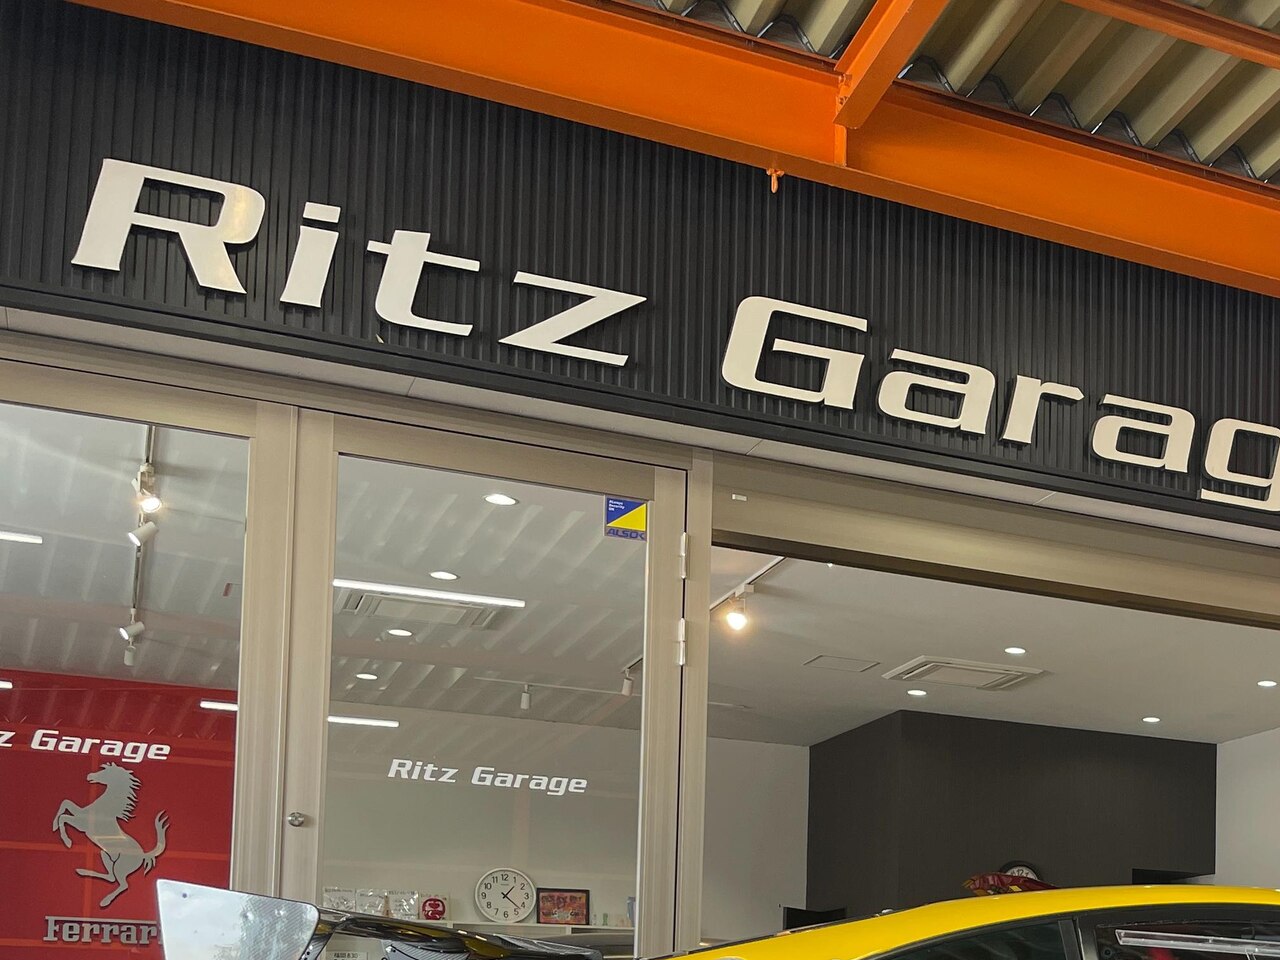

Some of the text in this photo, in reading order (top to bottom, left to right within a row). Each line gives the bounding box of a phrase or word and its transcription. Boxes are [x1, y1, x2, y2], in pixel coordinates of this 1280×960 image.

[71, 157, 647, 367] Ritz
[608, 528, 646, 540] ALSOK
[30, 729, 171, 763] Garage
[387, 758, 588, 796] Ritz Garage
[492, 876, 499, 884] 11
[500, 873, 509, 881] 12
[513, 876, 517, 884] 1
[483, 882, 492, 890] 10
[524, 892, 530, 900] 3
[486, 901, 492, 909] 8
[520, 901, 526, 909] 4
[494, 908, 499, 916] 7
[503, 911, 509, 919] 6
[513, 908, 519, 916] 5
[43, 915, 162, 945] Ferrar
